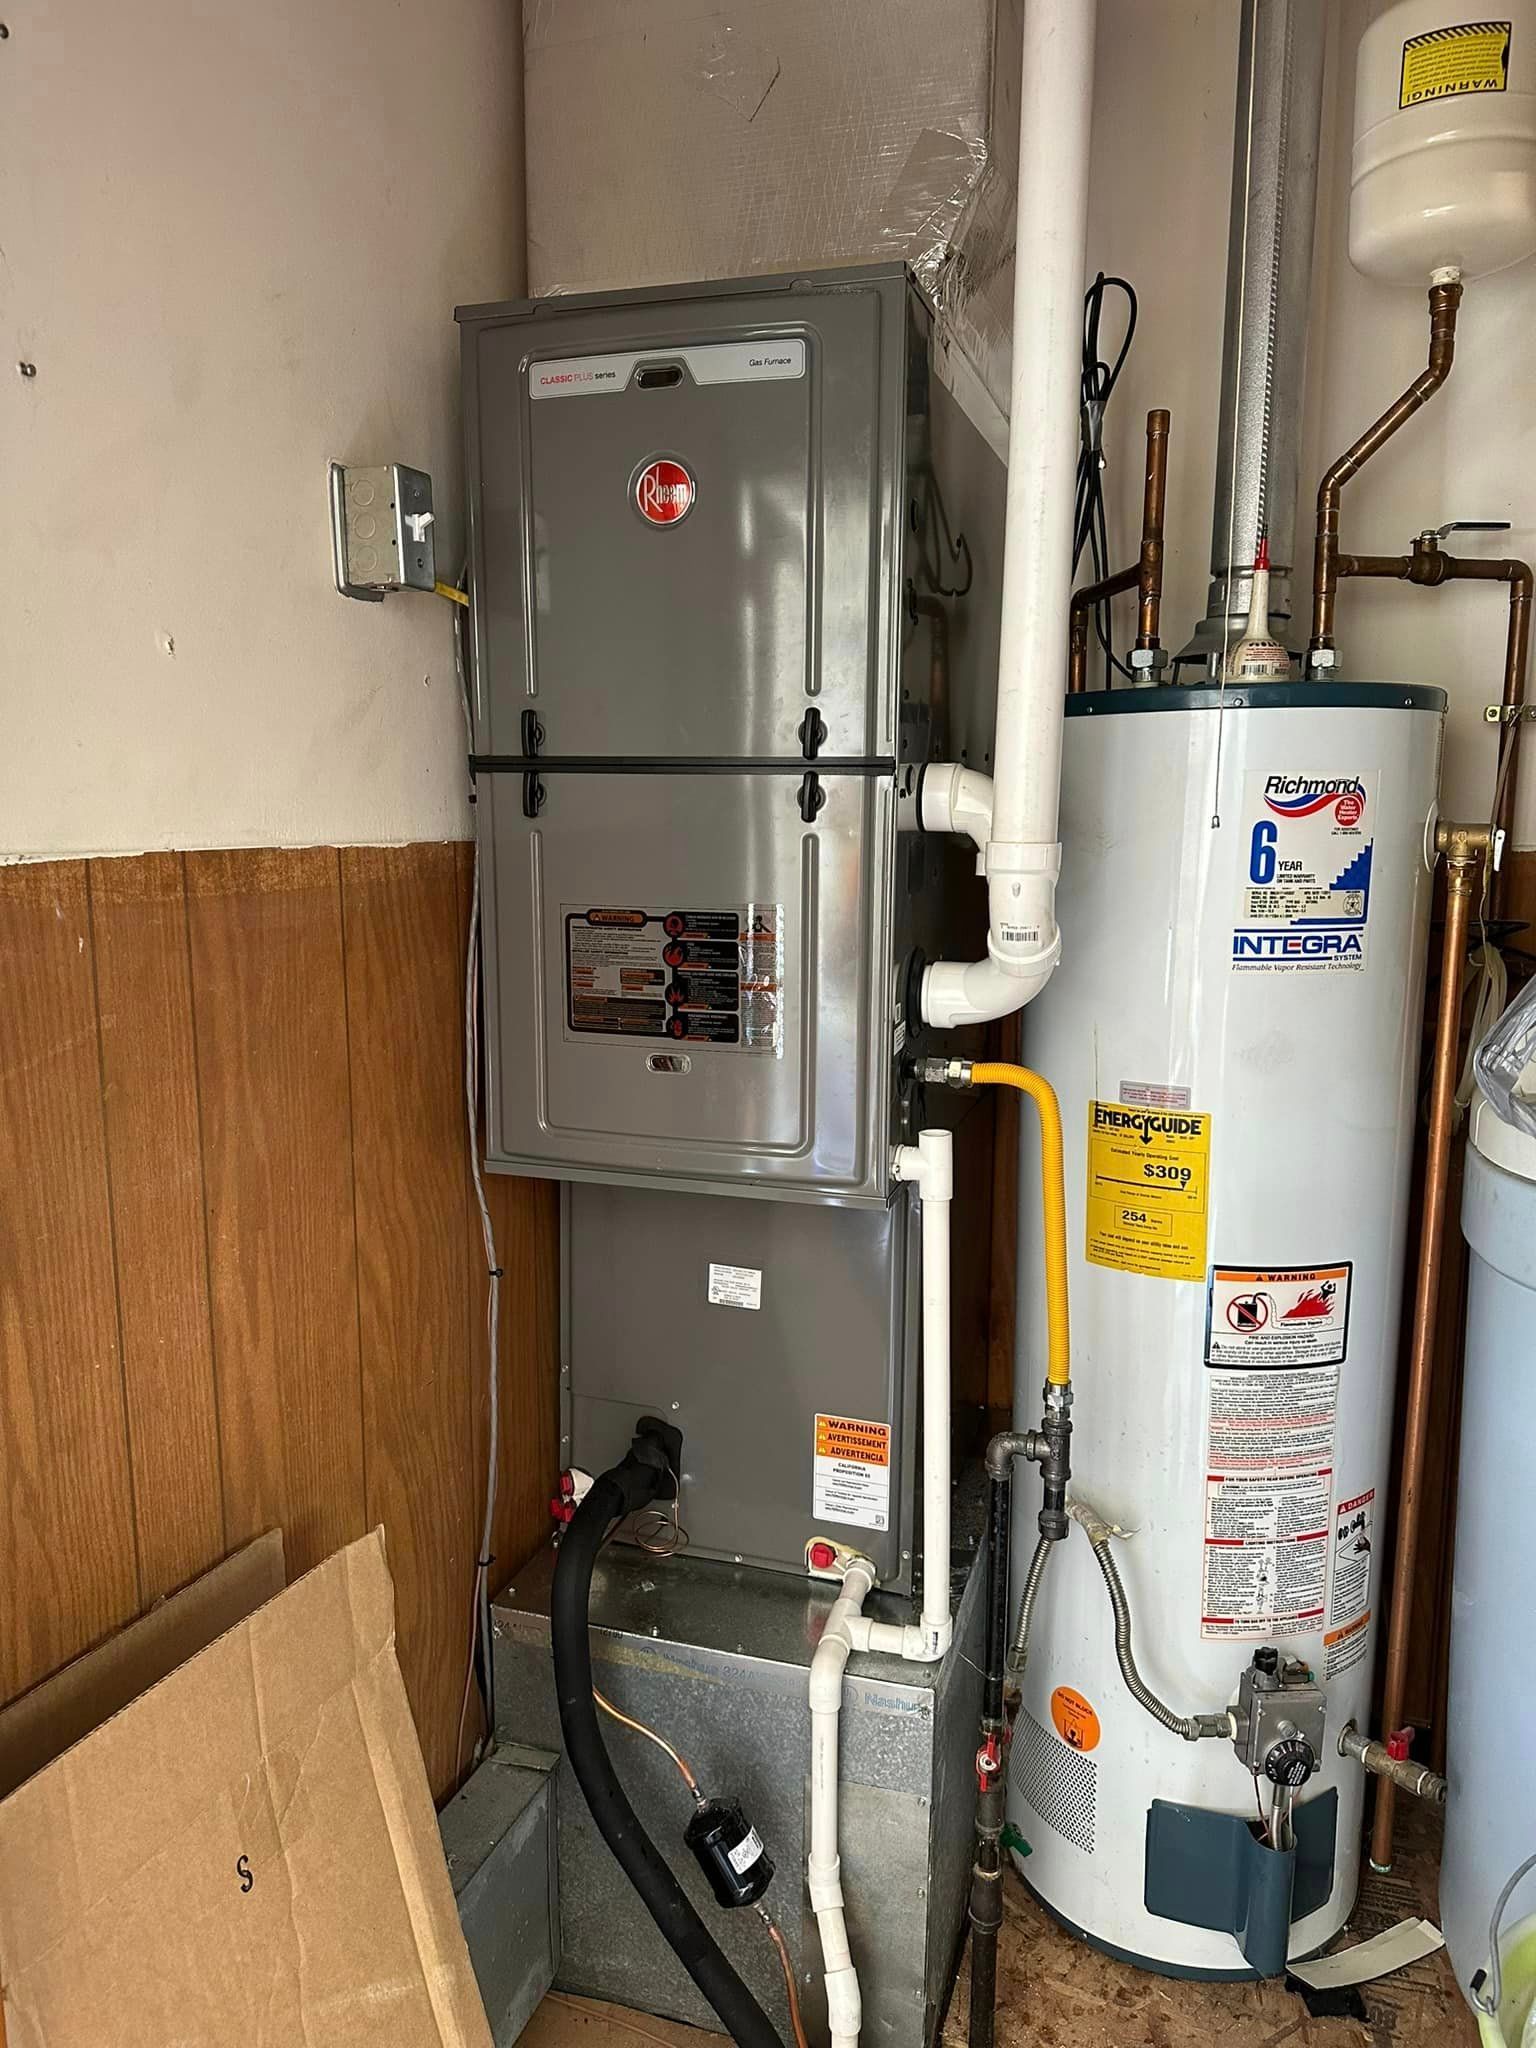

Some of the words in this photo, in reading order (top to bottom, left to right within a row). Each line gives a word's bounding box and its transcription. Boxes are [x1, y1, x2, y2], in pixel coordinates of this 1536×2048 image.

[1407, 79, 1498, 103] WARNING!
[749, 357, 763, 367] Gas
[764, 356, 792, 367] Furnace
[540, 373, 573, 385] CLASSIC
[574, 372, 594, 382] PLUS
[594, 370, 616, 380] series
[643, 465, 687, 512] Rheem
[1264, 775, 1360, 794] Richmond
[1249, 820, 1278, 884] 6
[1278, 860, 1303, 871] YEAR
[1232, 934, 1362, 954] INTEGRA
[1333, 953, 1362, 961] SYSTEM
[1144, 1163, 1192, 1181] $309
[1121, 1209, 1147, 1223] 254
[1267, 1273, 1316, 1281] WARNING
[827, 1420, 887, 1436] WARNING
[827, 1433, 887, 1450] AVERTISSEMENT
[830, 1447, 884, 1462] ADVERTENCIA
[832, 1468, 864, 1478] PROPOSITION
[837, 1462, 866, 1471] CALIFORNIA
